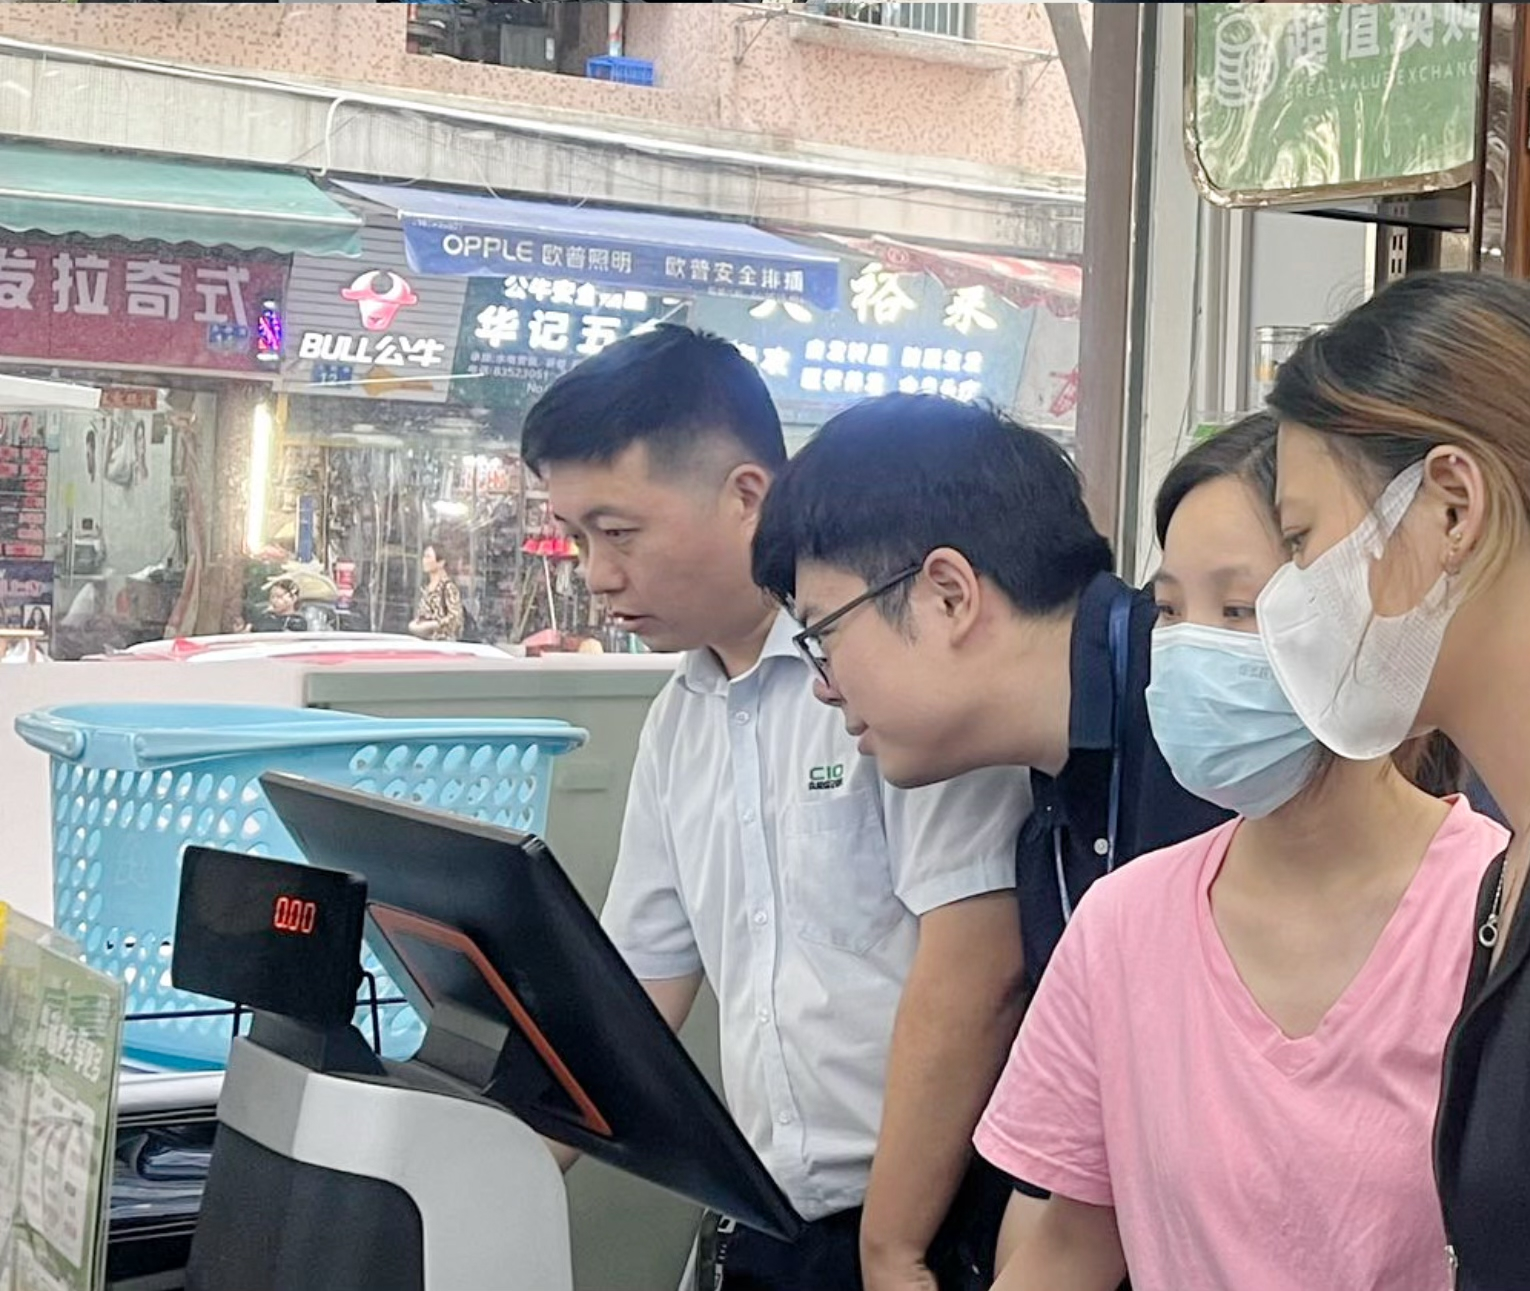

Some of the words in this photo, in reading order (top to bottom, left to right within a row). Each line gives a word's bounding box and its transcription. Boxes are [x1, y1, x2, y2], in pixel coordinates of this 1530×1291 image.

[442, 234, 535, 264] OPPLE
[541, 244, 633, 274] 欧普照明
[299, 331, 446, 368] BULL公牛
[474, 304, 662, 357] 华记五
